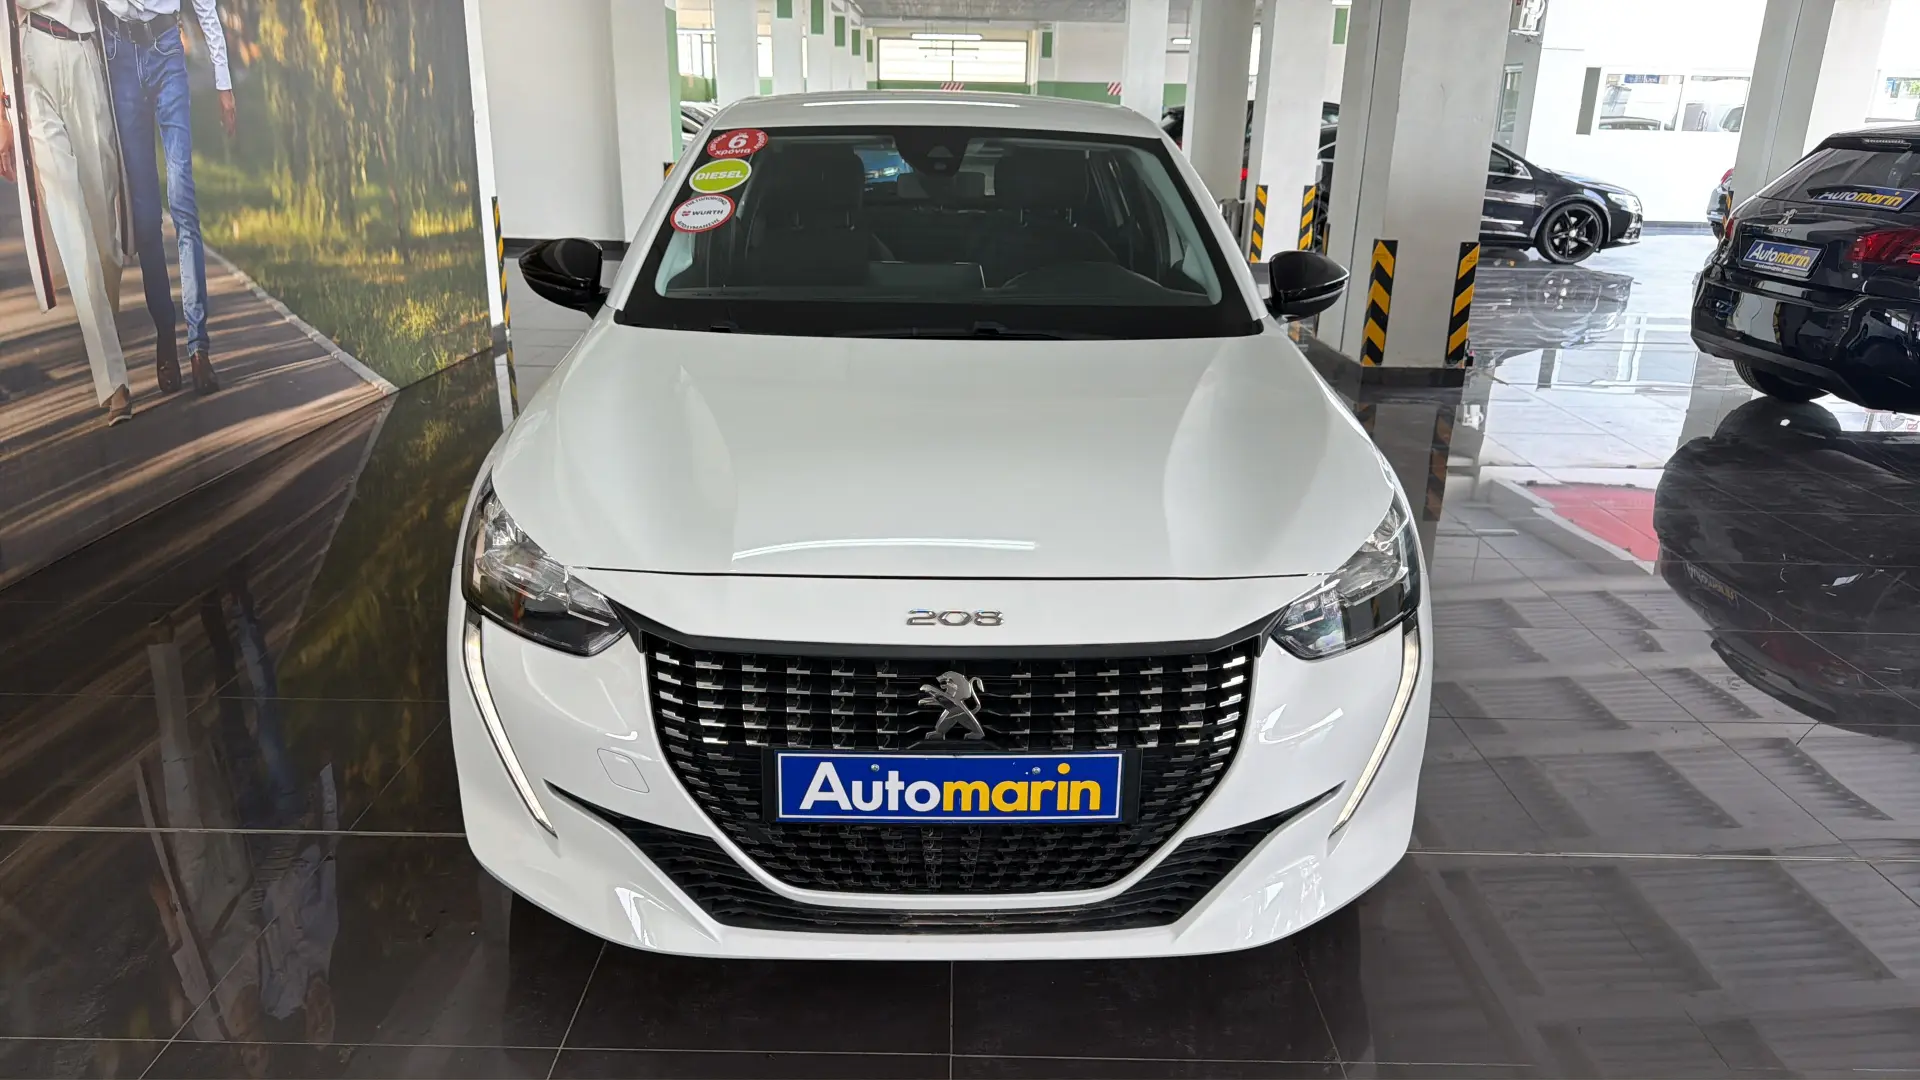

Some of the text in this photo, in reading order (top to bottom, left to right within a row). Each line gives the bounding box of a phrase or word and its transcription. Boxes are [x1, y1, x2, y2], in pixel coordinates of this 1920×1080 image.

[728, 134, 749, 149] 6
[696, 171, 743, 180] DIESEL
[1748, 243, 1811, 268] Automarin
[906, 609, 1004, 626] 208
[799, 761, 1101, 812] Automarin
